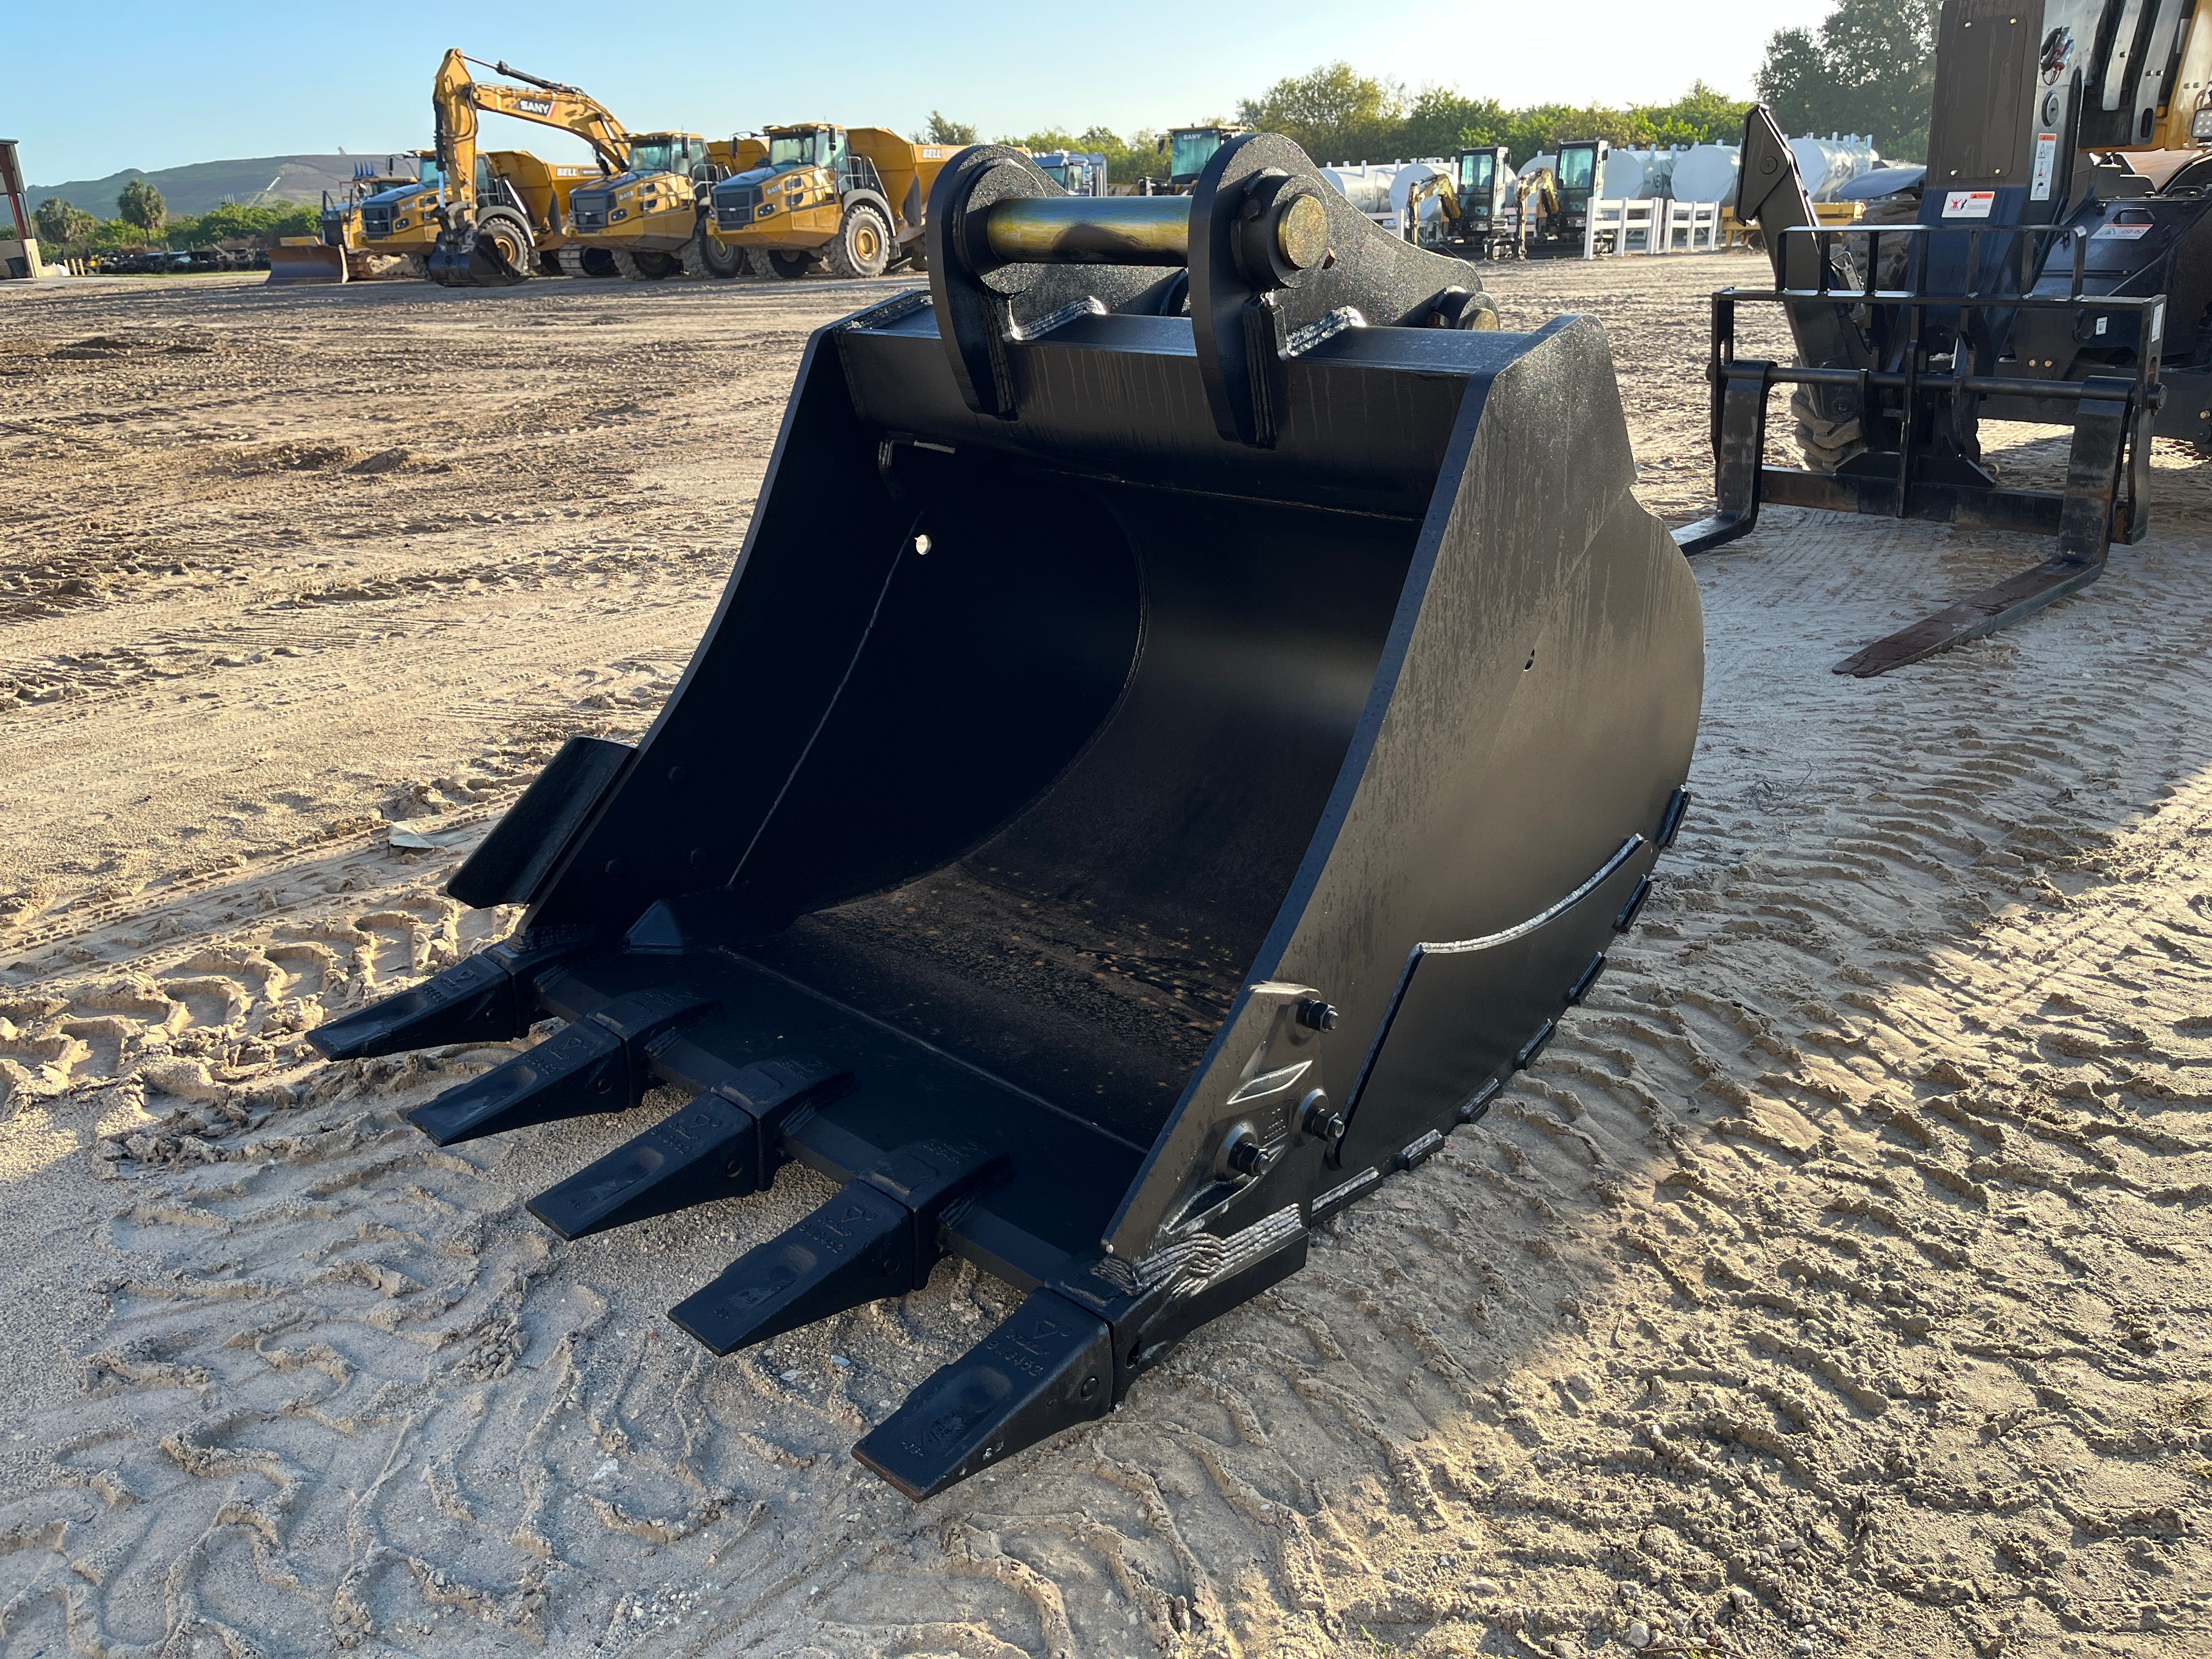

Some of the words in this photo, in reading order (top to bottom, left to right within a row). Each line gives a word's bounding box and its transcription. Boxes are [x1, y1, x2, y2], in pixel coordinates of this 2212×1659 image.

[520, 100, 549, 114] SANY
[922, 148, 941, 159] BELL
[556, 167, 577, 176] BELL
